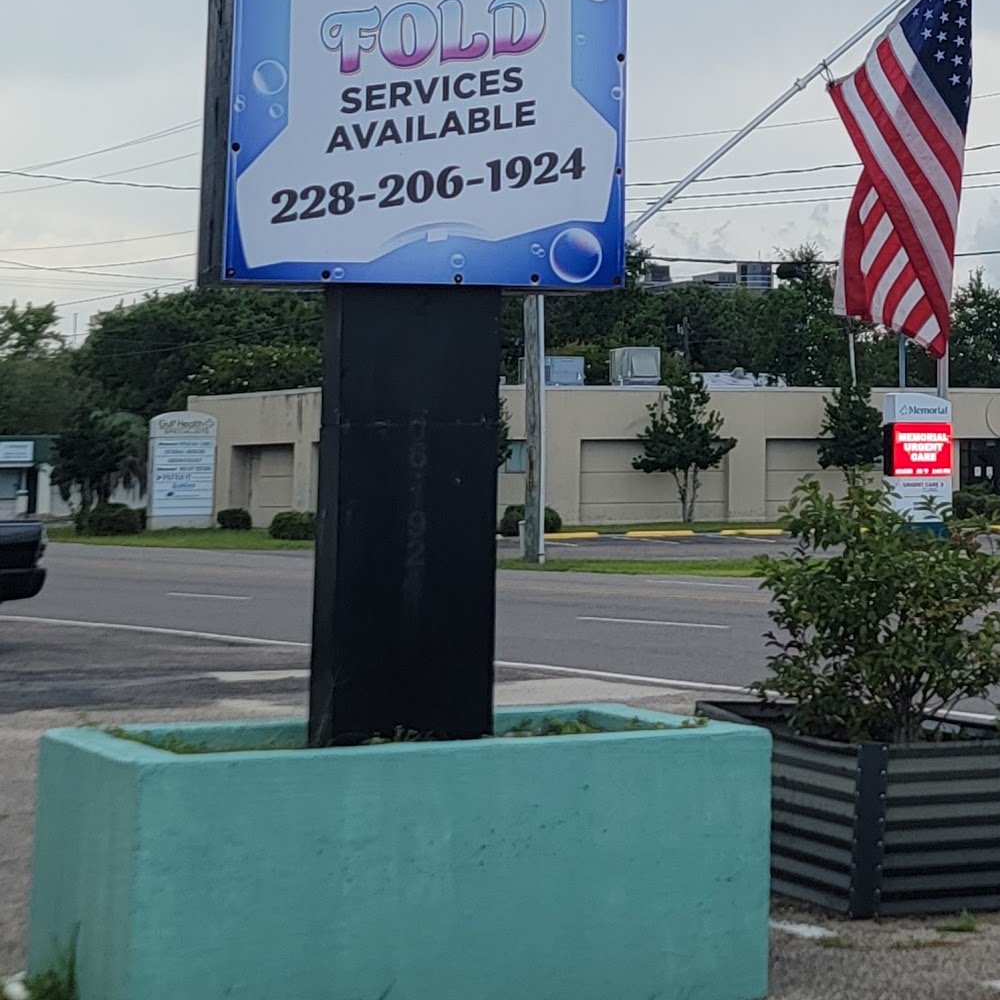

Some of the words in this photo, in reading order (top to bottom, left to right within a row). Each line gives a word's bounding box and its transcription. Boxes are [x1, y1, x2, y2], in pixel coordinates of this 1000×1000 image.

[340, 66, 524, 115] SERVICES
[325, 99, 537, 154] AVAILABLE
[271, 147, 587, 224] 228-206-1924
[908, 406, 948, 415] Memorial
[898, 432, 949, 442] MEMORIAL
[903, 442, 944, 452] URGENT
[910, 452, 937, 462] CARE
